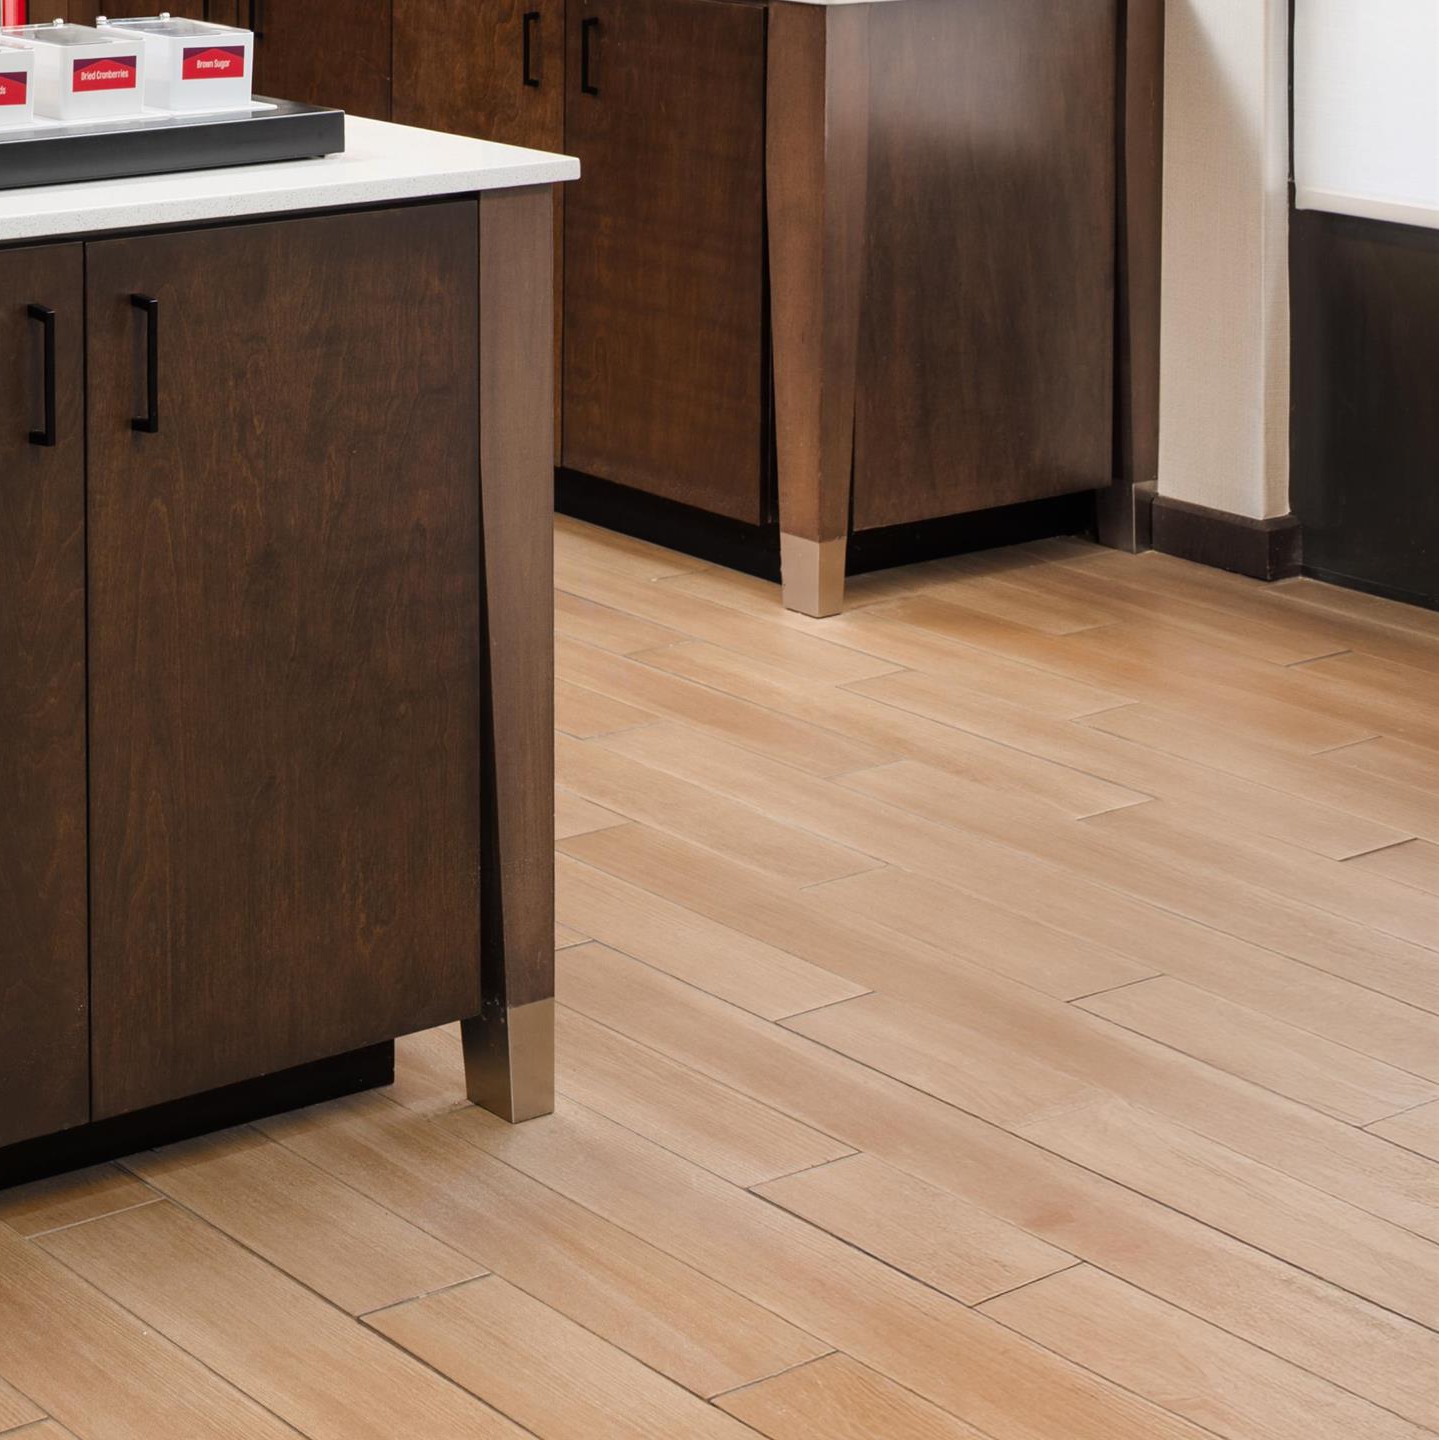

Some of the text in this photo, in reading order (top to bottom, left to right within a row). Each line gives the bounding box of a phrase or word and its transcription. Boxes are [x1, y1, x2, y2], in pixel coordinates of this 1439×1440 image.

[196, 58, 231, 70] Brown Sugar
[80, 69, 129, 81] Dried Cranberries
